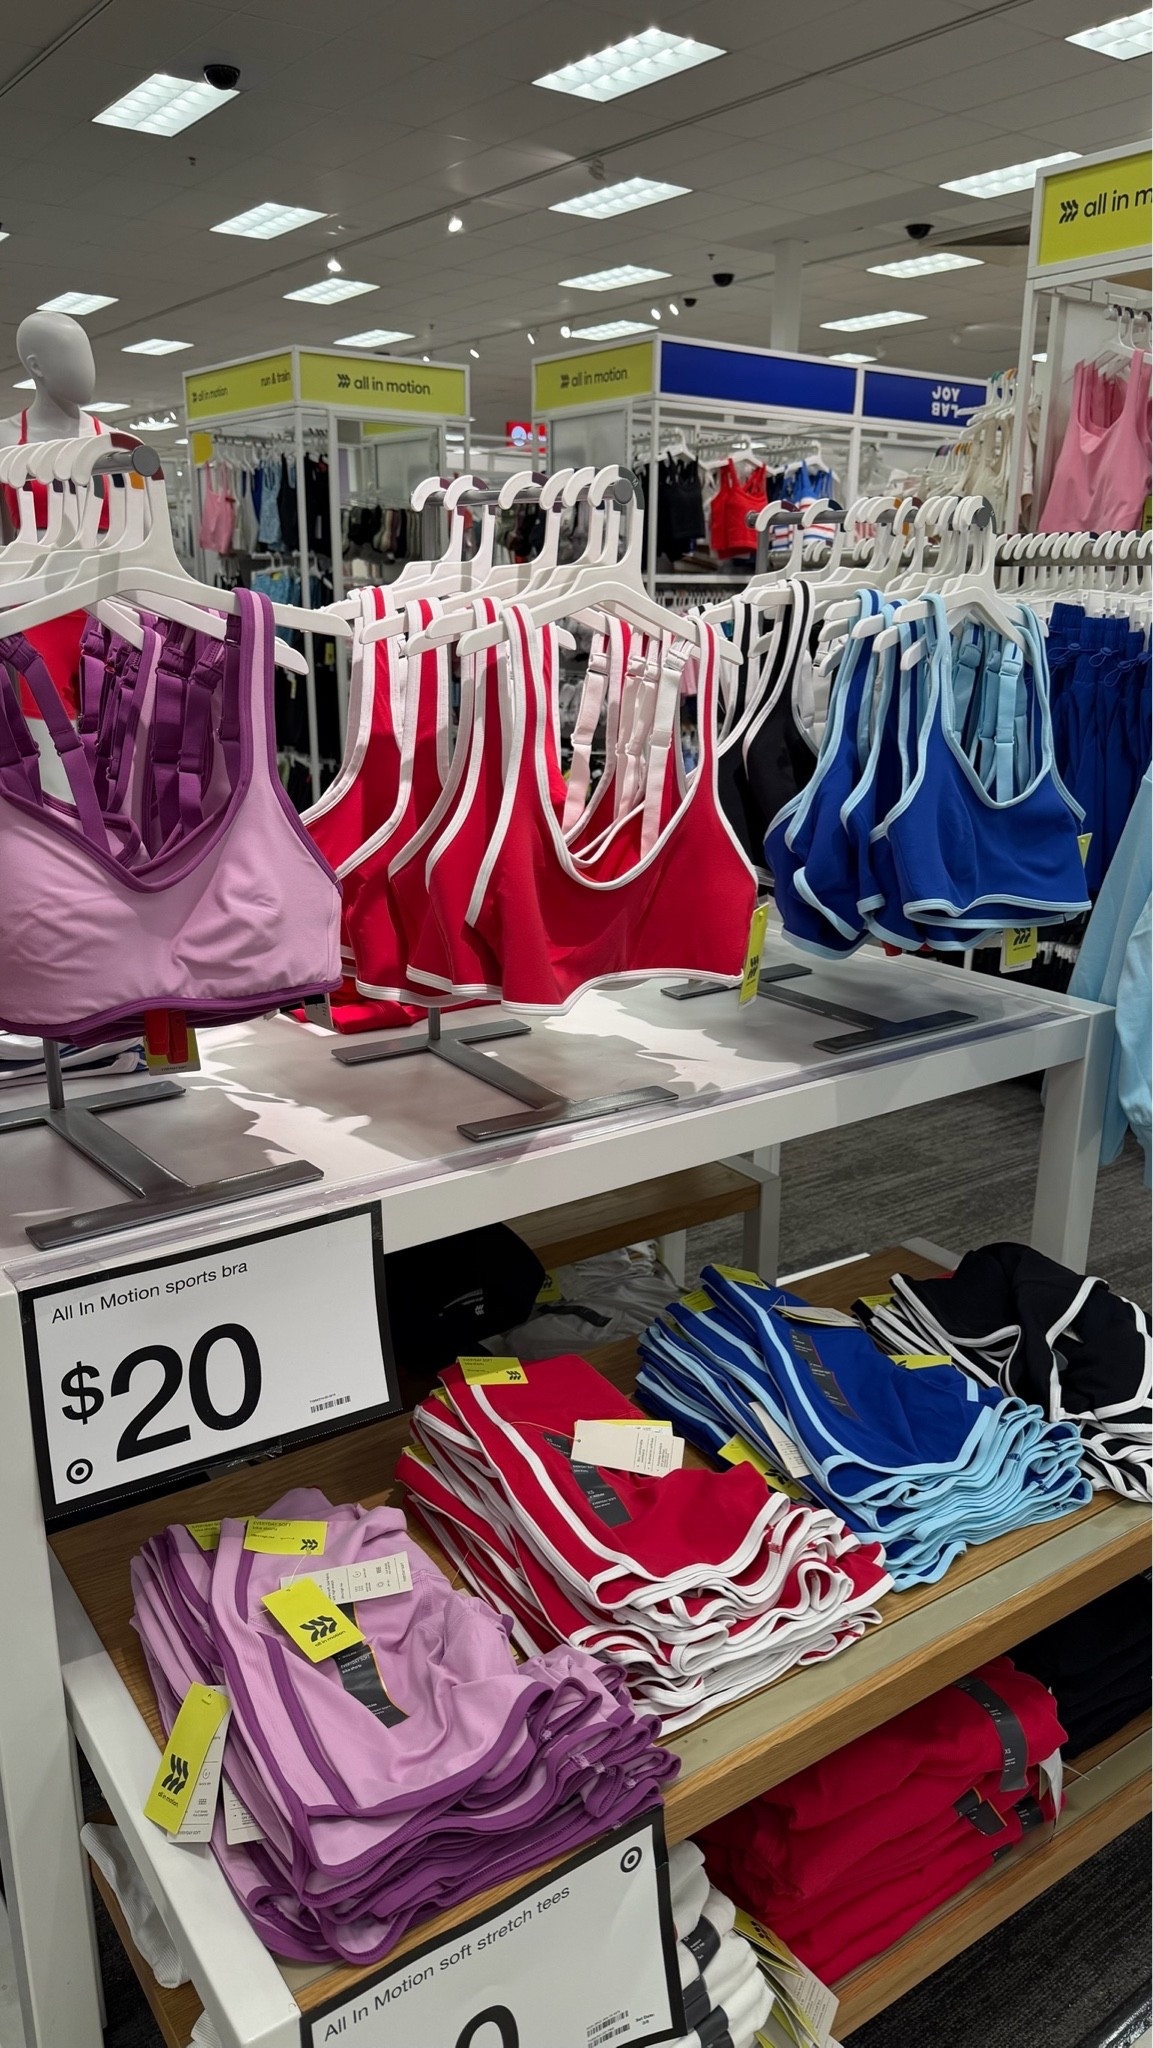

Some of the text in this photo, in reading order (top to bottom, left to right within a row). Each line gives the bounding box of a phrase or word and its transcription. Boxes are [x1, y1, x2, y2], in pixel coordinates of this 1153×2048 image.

[1084, 192, 1107, 218] all
[1112, 189, 1129, 212] in
[261, 377, 271, 387] run
[354, 376, 431, 395] all in motion
[571, 367, 628, 387] all in motion
[932, 386, 960, 402] JOY
[51, 1262, 248, 1324] All In Motion sports bra
[60, 1322, 262, 1463] $20
[327, 1630, 346, 1641] motion
[166, 1796, 179, 1807] motion
[324, 1886, 570, 2042] All In Motion soft stretch tees
